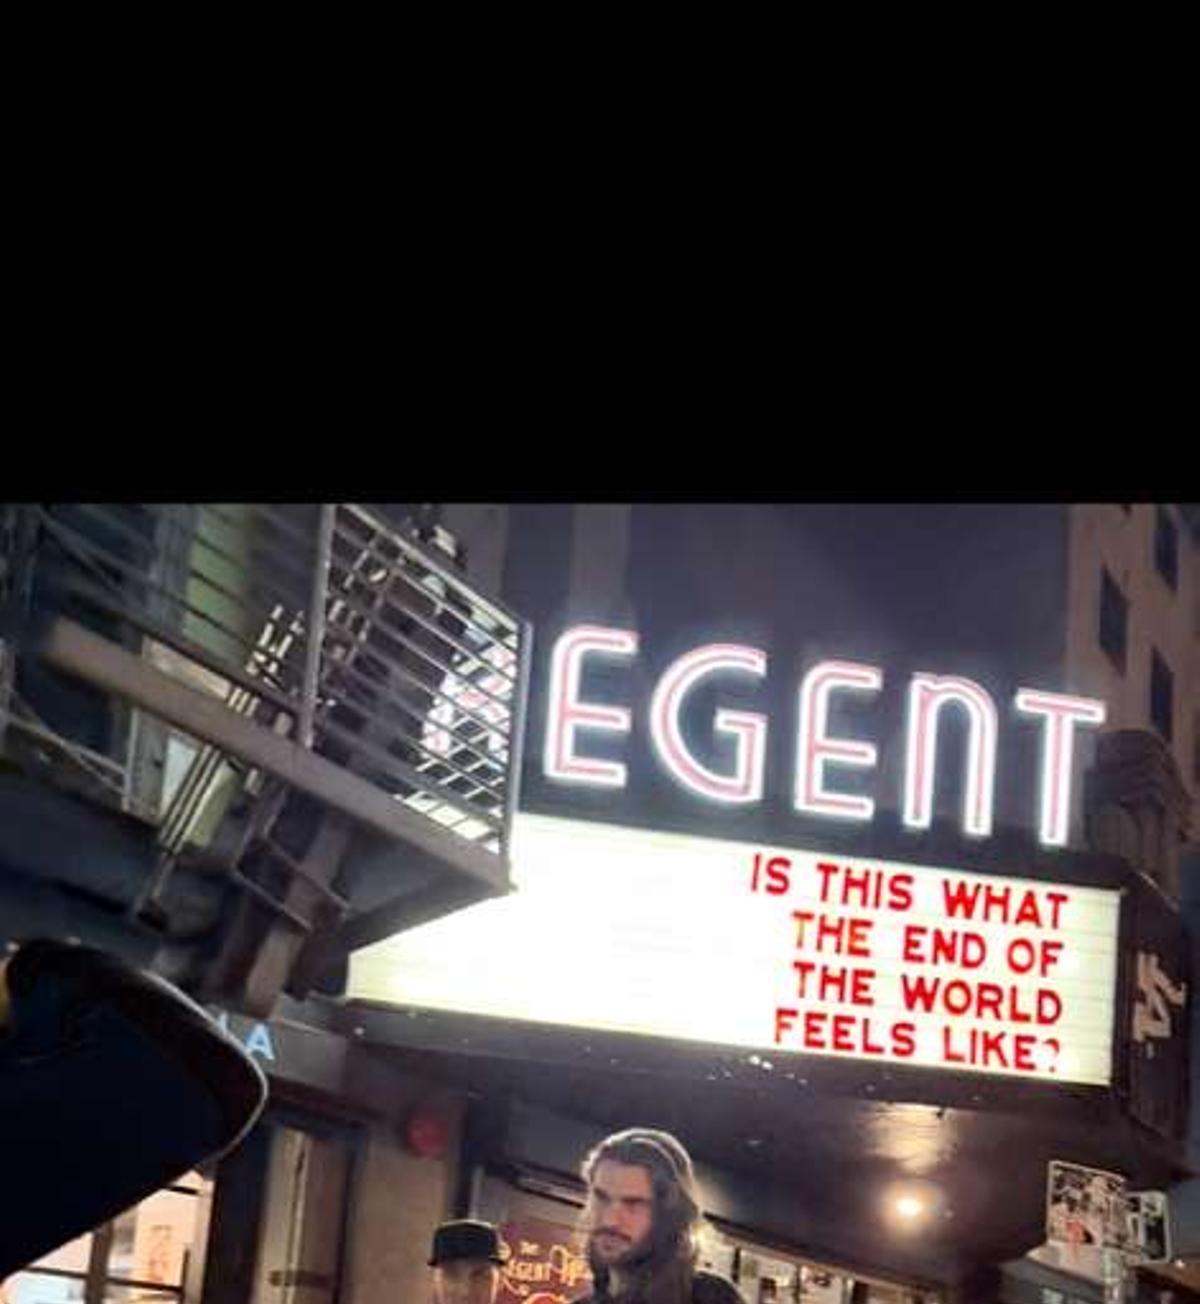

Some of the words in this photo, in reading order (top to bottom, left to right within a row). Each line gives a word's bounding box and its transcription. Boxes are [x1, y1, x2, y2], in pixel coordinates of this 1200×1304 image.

[750, 853, 792, 897] IS
[815, 862, 914, 913] THIS
[943, 879, 1070, 930] WHAT
[790, 910, 874, 959] THE
[902, 924, 987, 971] END
[1005, 937, 1063, 978] OF
[793, 960, 876, 1007] THE
[900, 973, 1064, 1027] WORLD
[774, 1007, 917, 1058] FEELS
[942, 1025, 1061, 1074] LIKE?
